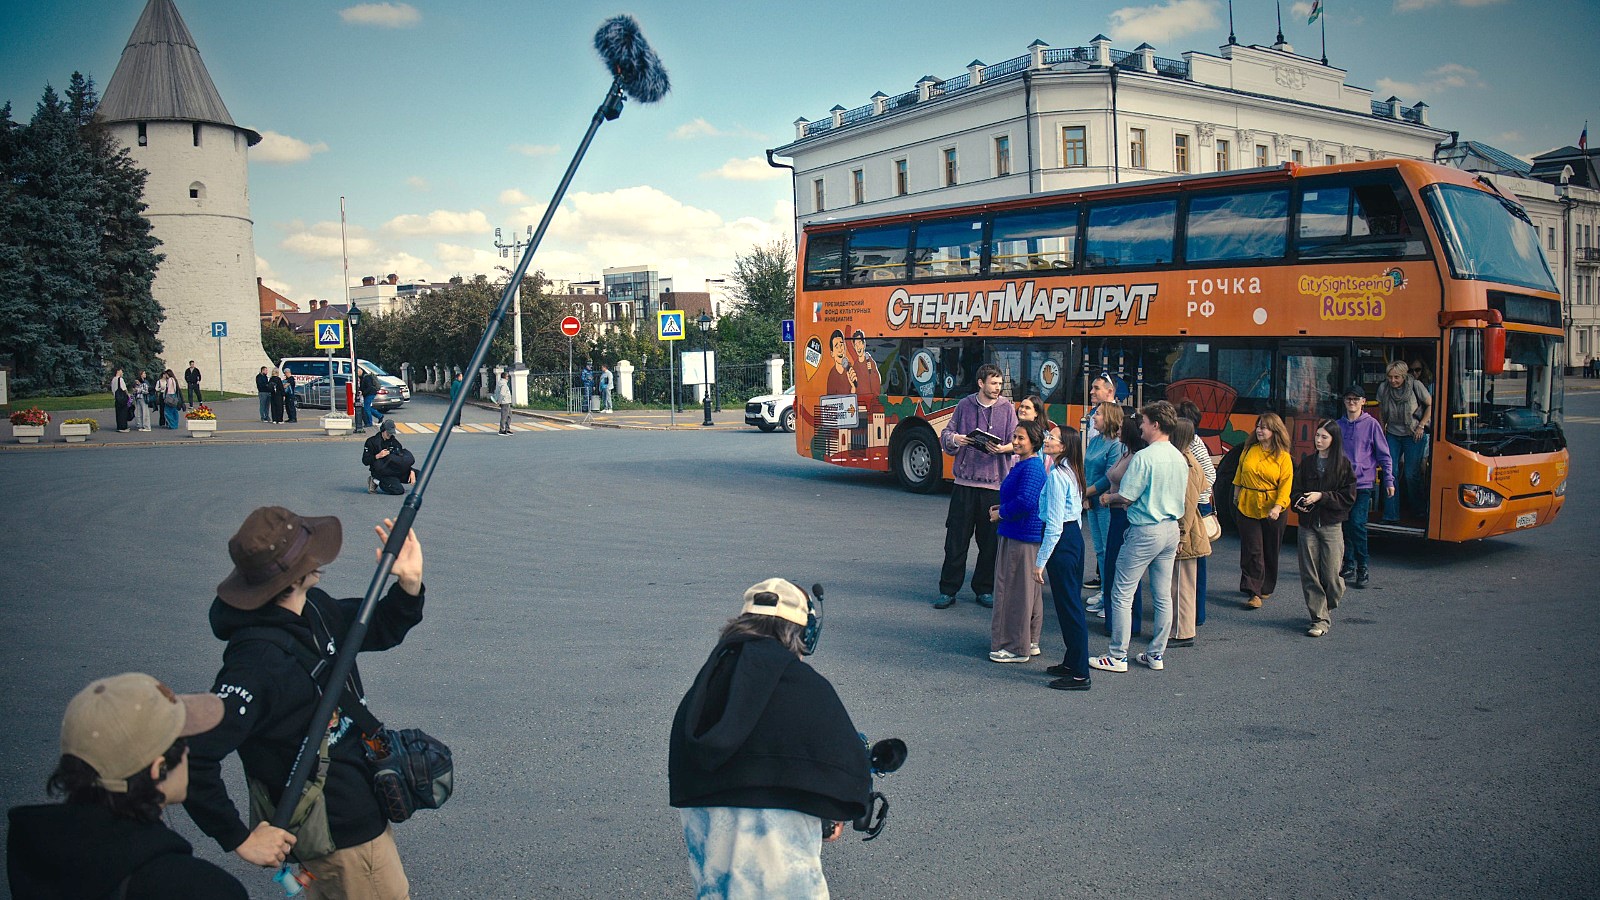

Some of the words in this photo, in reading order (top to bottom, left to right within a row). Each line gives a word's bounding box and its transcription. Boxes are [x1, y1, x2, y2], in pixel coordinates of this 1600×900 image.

[824, 299, 865, 308] ПРЕЗИДЕНТСКИЙ
[1323, 295, 1382, 317] Russia
[215, 323, 224, 336] P
